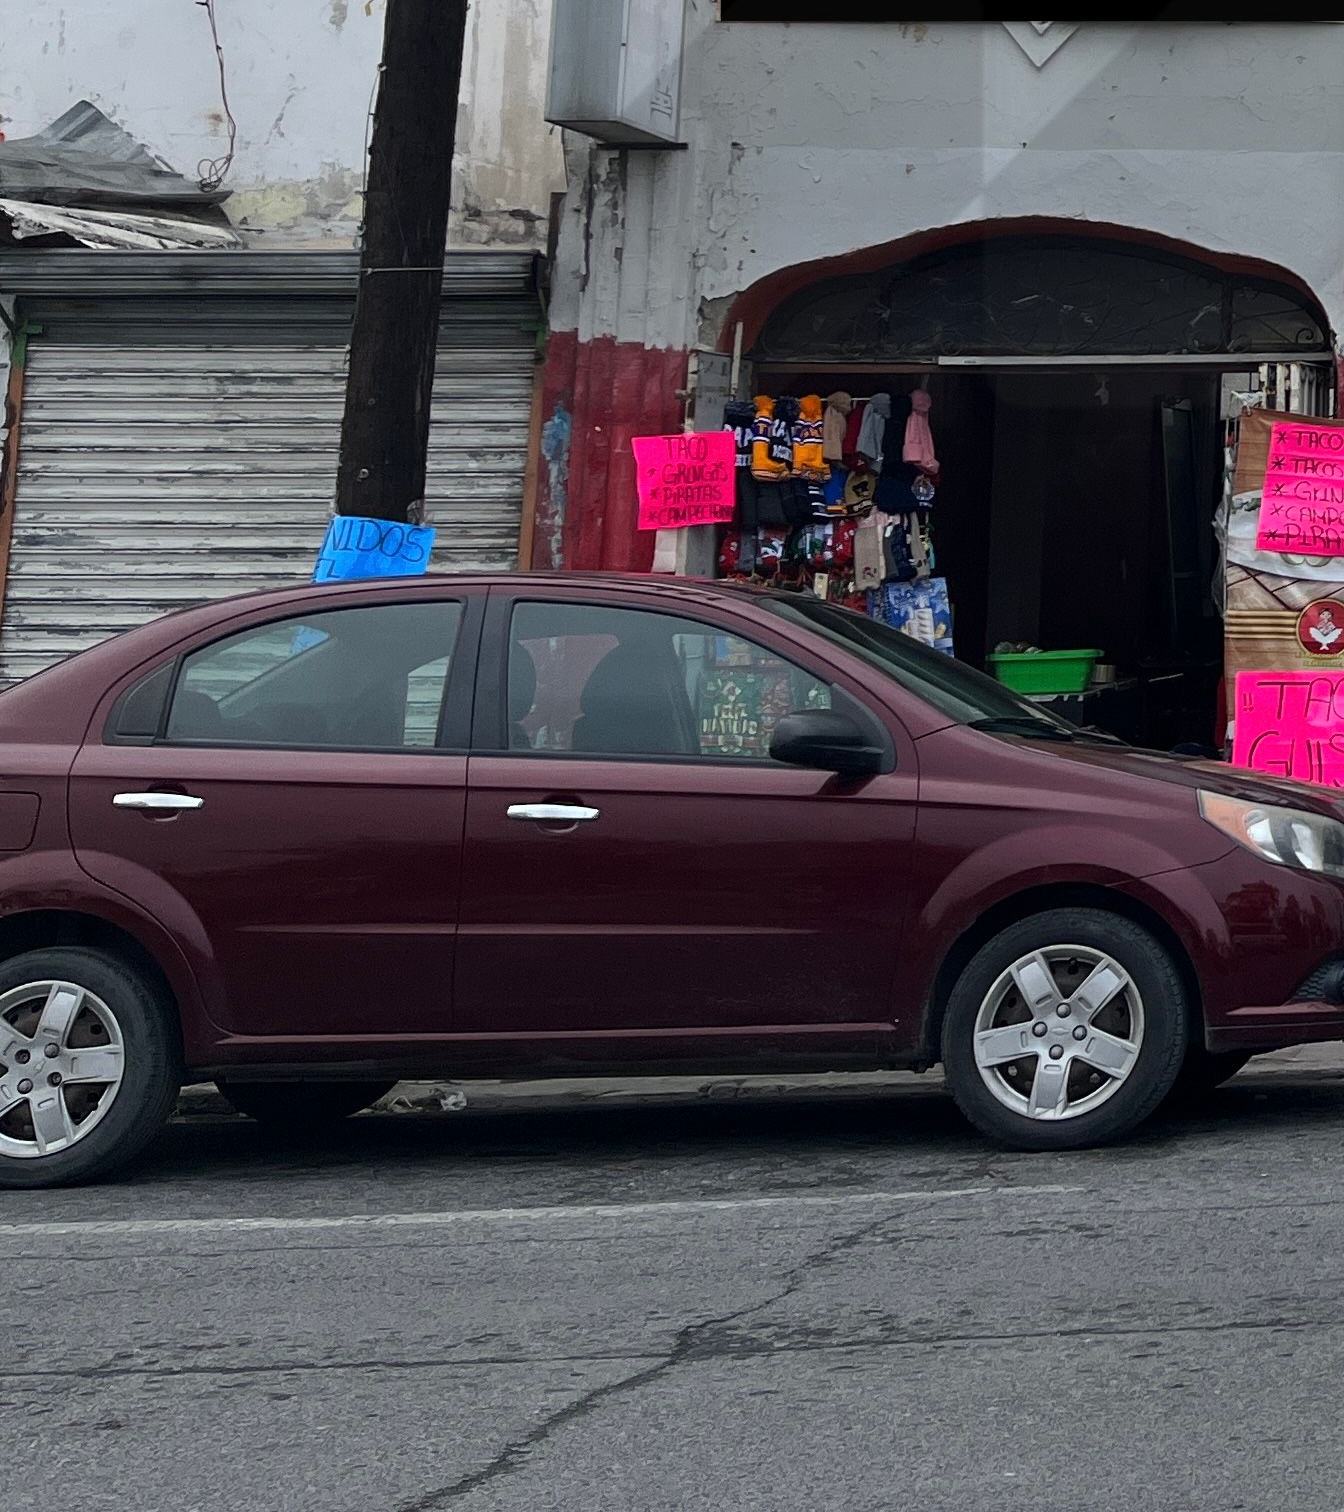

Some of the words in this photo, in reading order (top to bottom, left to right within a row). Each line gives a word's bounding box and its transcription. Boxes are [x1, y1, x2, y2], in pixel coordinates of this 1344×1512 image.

[662, 437, 709, 462] TACO
[1293, 431, 1344, 452] TACO
[1291, 457, 1344, 478] TACOS
